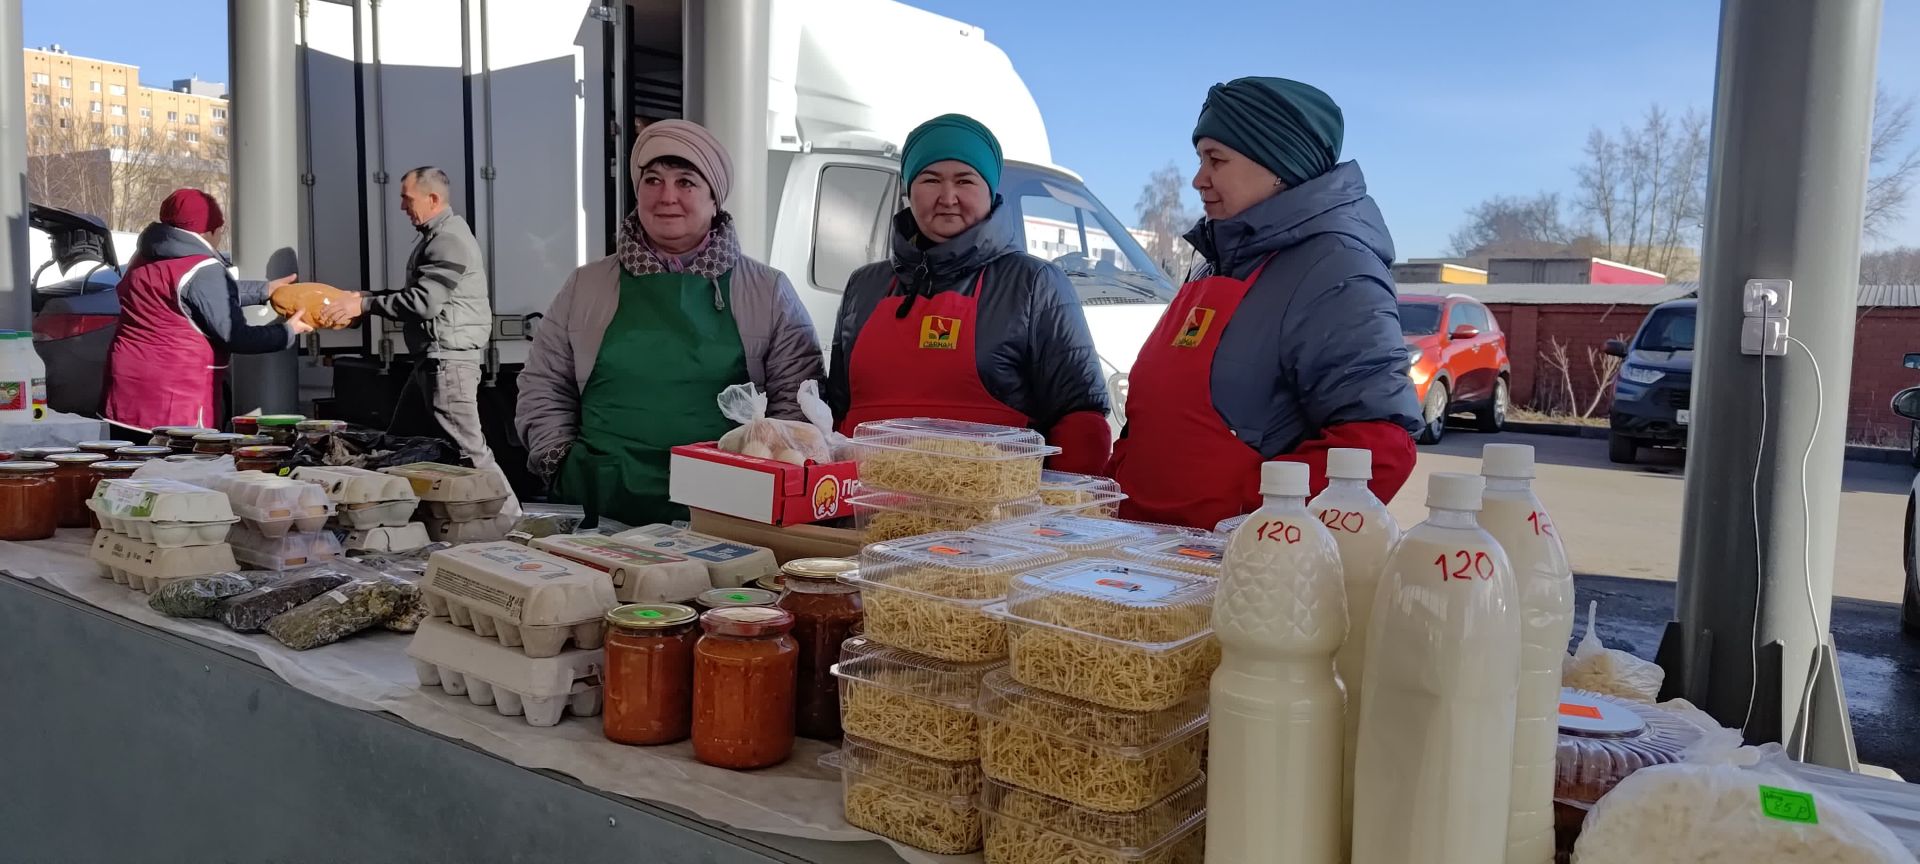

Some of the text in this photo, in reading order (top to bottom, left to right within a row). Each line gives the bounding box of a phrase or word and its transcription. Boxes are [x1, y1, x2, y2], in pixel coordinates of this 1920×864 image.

[1257, 521, 1301, 544] 120
[1318, 508, 1364, 534] 120
[1527, 511, 1554, 538] 12
[1434, 550, 1494, 582] 120
